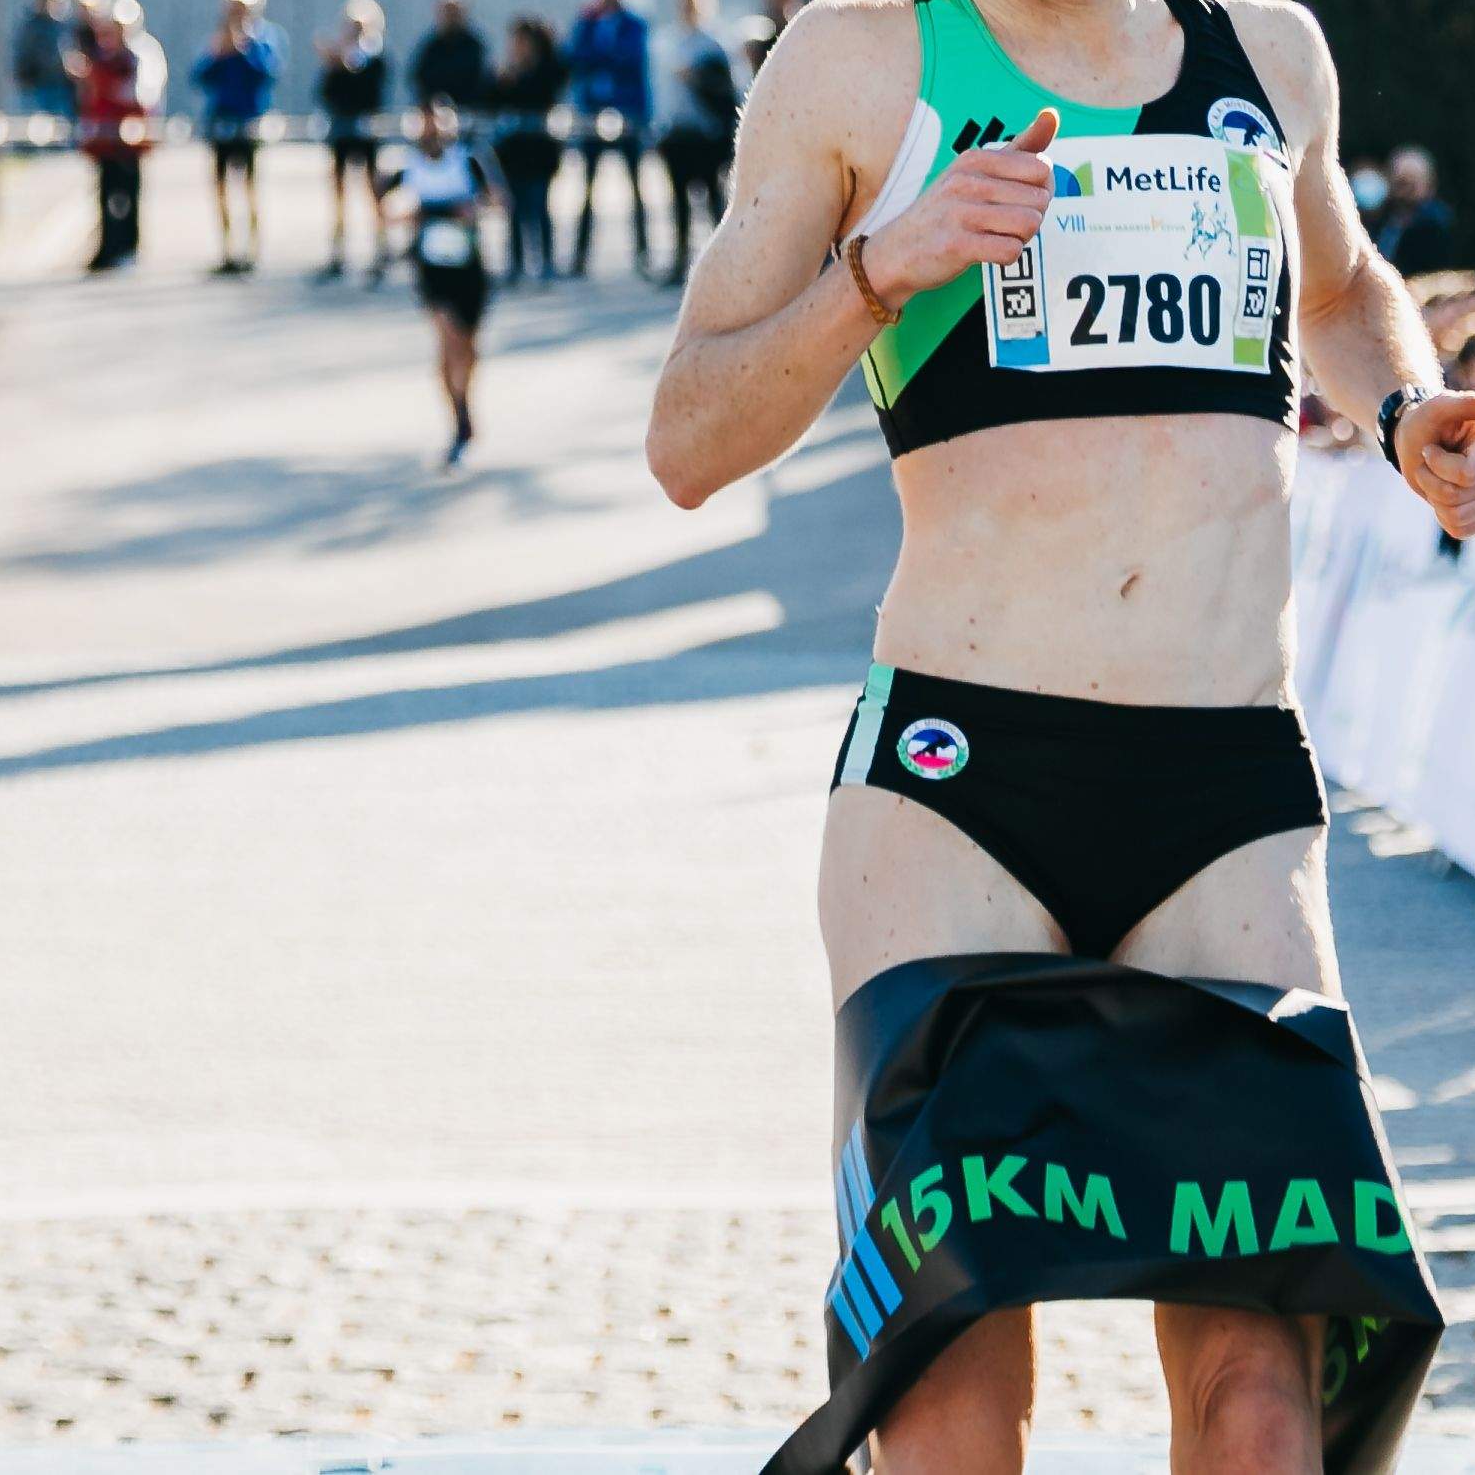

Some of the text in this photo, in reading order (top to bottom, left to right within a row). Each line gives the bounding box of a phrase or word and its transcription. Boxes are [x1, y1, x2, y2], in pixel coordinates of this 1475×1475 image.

[1106, 164, 1222, 193] MetLife
[1056, 213, 1086, 234] VIII
[1066, 273, 1222, 347] 2780
[880, 1154, 1127, 1274] 15KM
